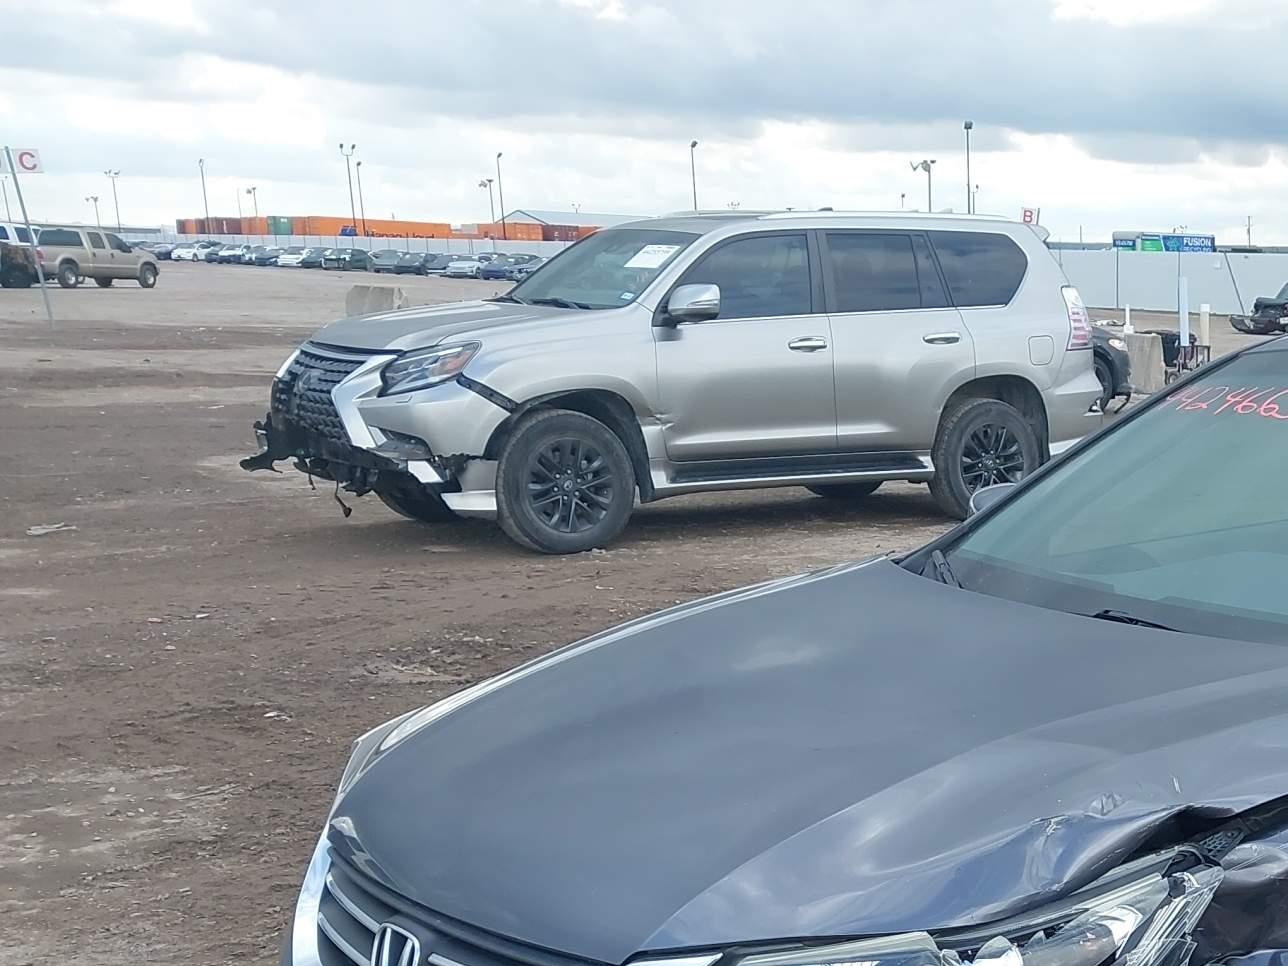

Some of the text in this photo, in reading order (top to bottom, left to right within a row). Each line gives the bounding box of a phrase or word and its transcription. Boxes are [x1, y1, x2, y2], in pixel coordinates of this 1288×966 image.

[18, 151, 37, 170] C
[1023, 209, 1033, 223] B
[1183, 237, 1212, 246] FUSION
